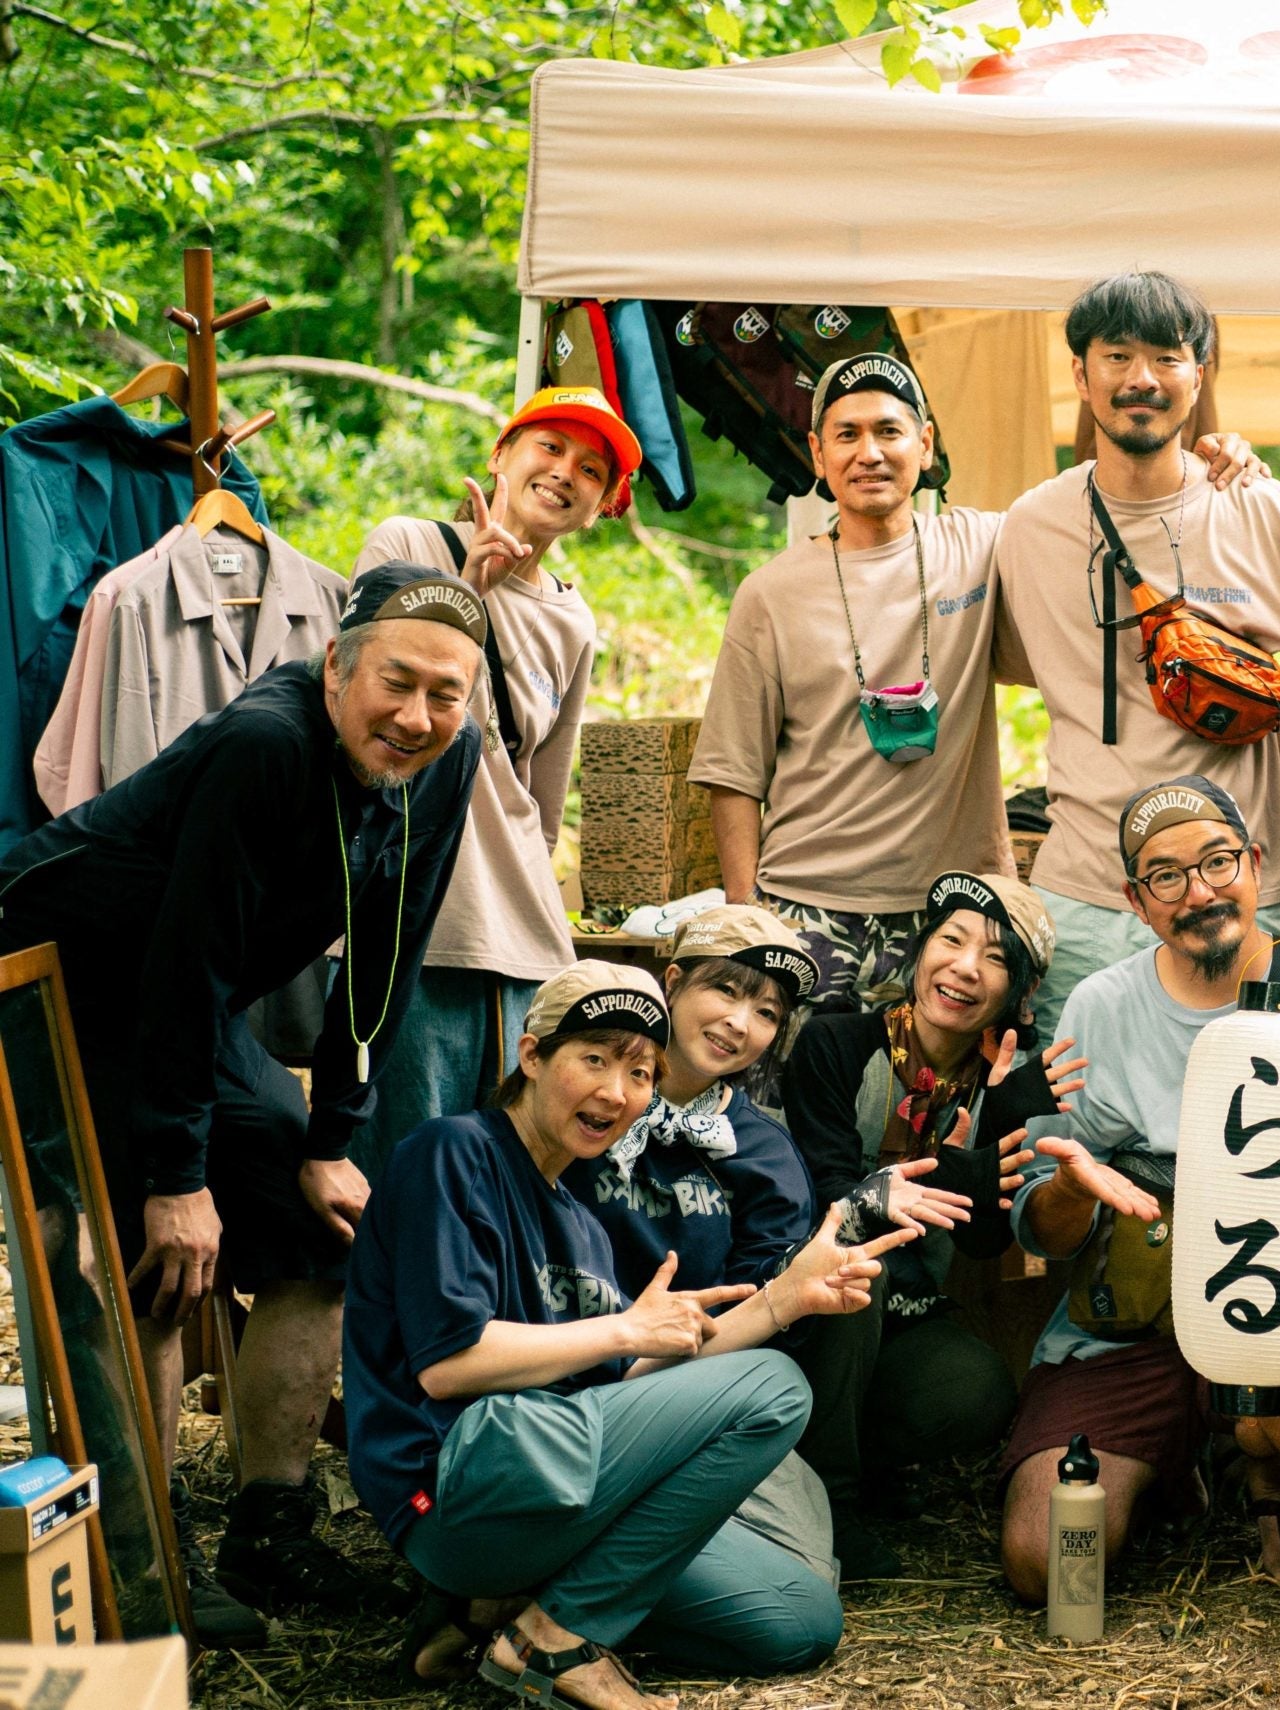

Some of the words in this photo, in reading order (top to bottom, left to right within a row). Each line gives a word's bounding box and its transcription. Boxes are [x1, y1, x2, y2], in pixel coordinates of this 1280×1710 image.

[838, 360, 909, 390] SAPPOROCITY
[400, 586, 481, 626] SAPPOROCITY
[1131, 791, 1205, 836] SAPPOROCITY
[931, 877, 994, 908] SAPPOROCITY
[581, 994, 662, 1027] SAPPOROCITY
[1061, 1530, 1097, 1540] ZERO
[1066, 1539, 1092, 1549] DAY
